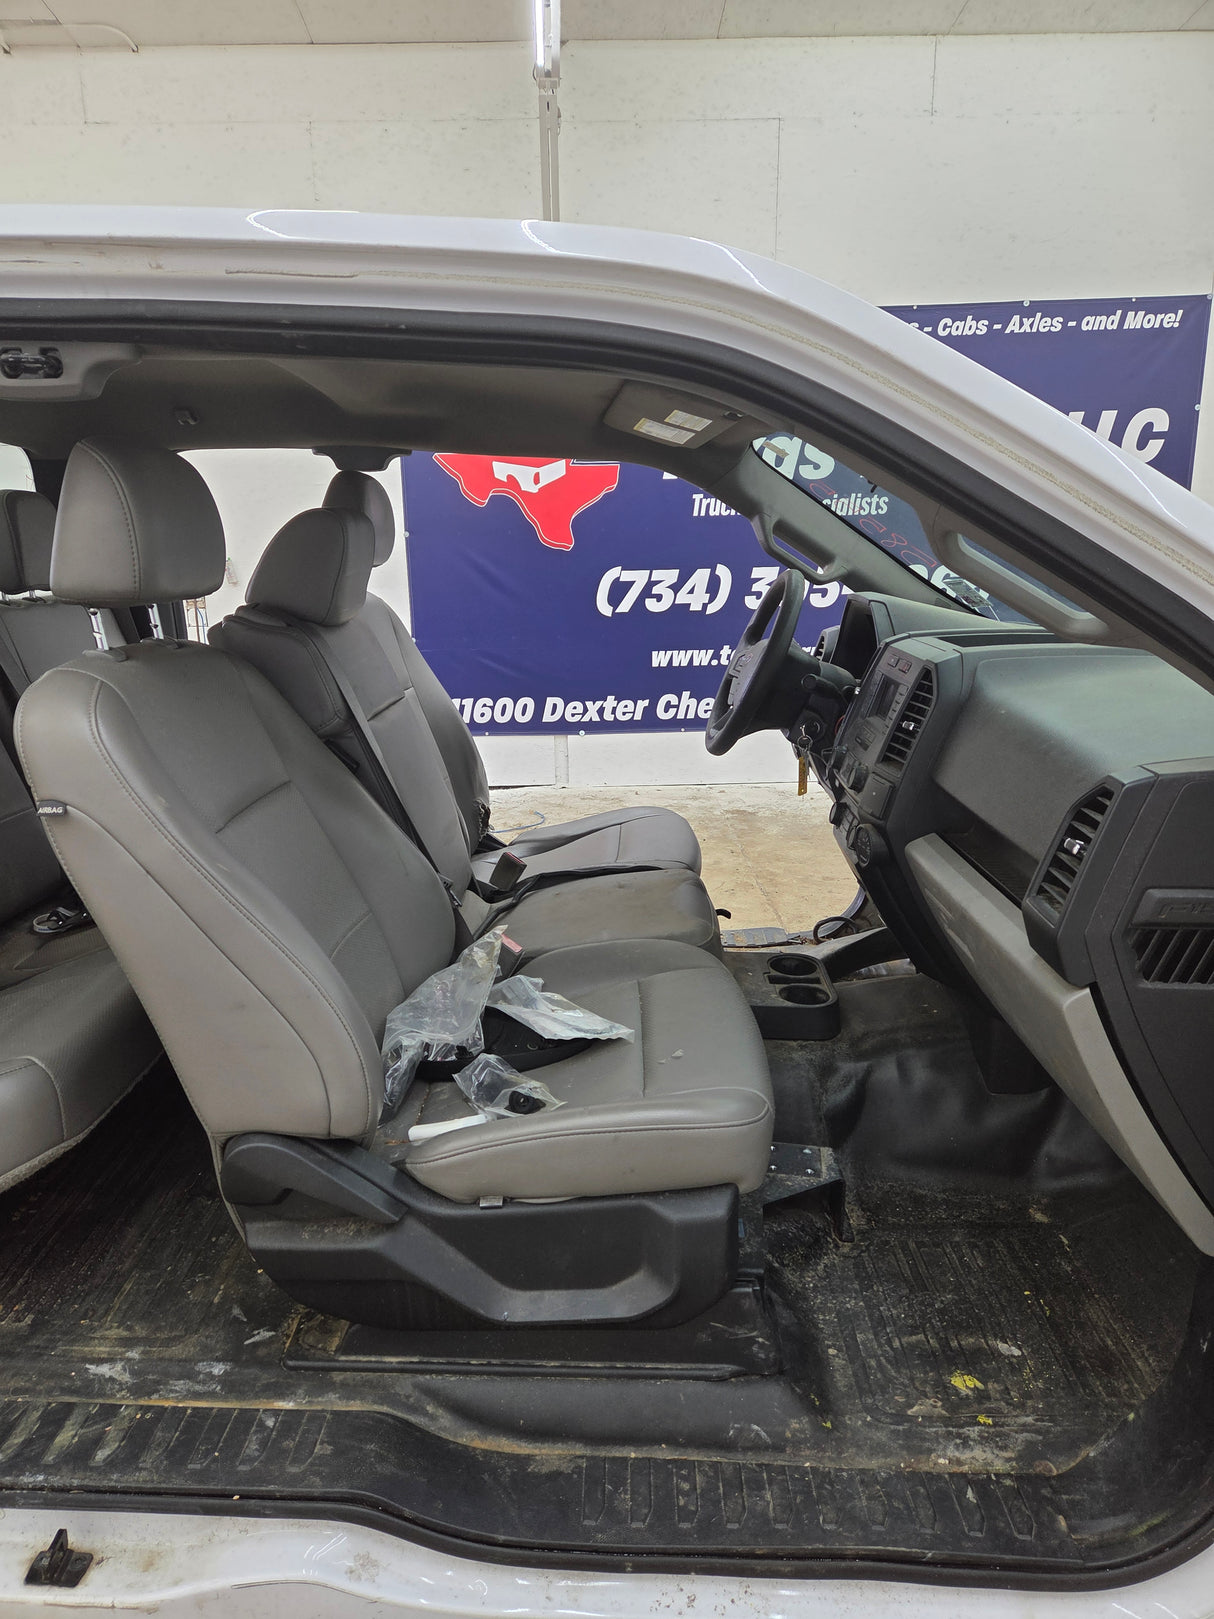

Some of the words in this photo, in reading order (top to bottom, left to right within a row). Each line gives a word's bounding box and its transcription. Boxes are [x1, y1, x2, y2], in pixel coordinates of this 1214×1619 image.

[937, 315, 988, 336] Cabs
[1004, 312, 1063, 334] Axles
[1081, 309, 1122, 331] and
[1123, 309, 1184, 330] More!
[596, 564, 733, 617] (734)
[651, 644, 736, 668] www.t
[542, 695, 650, 722] Dexter
[37, 806, 64, 814] AIRBAG
